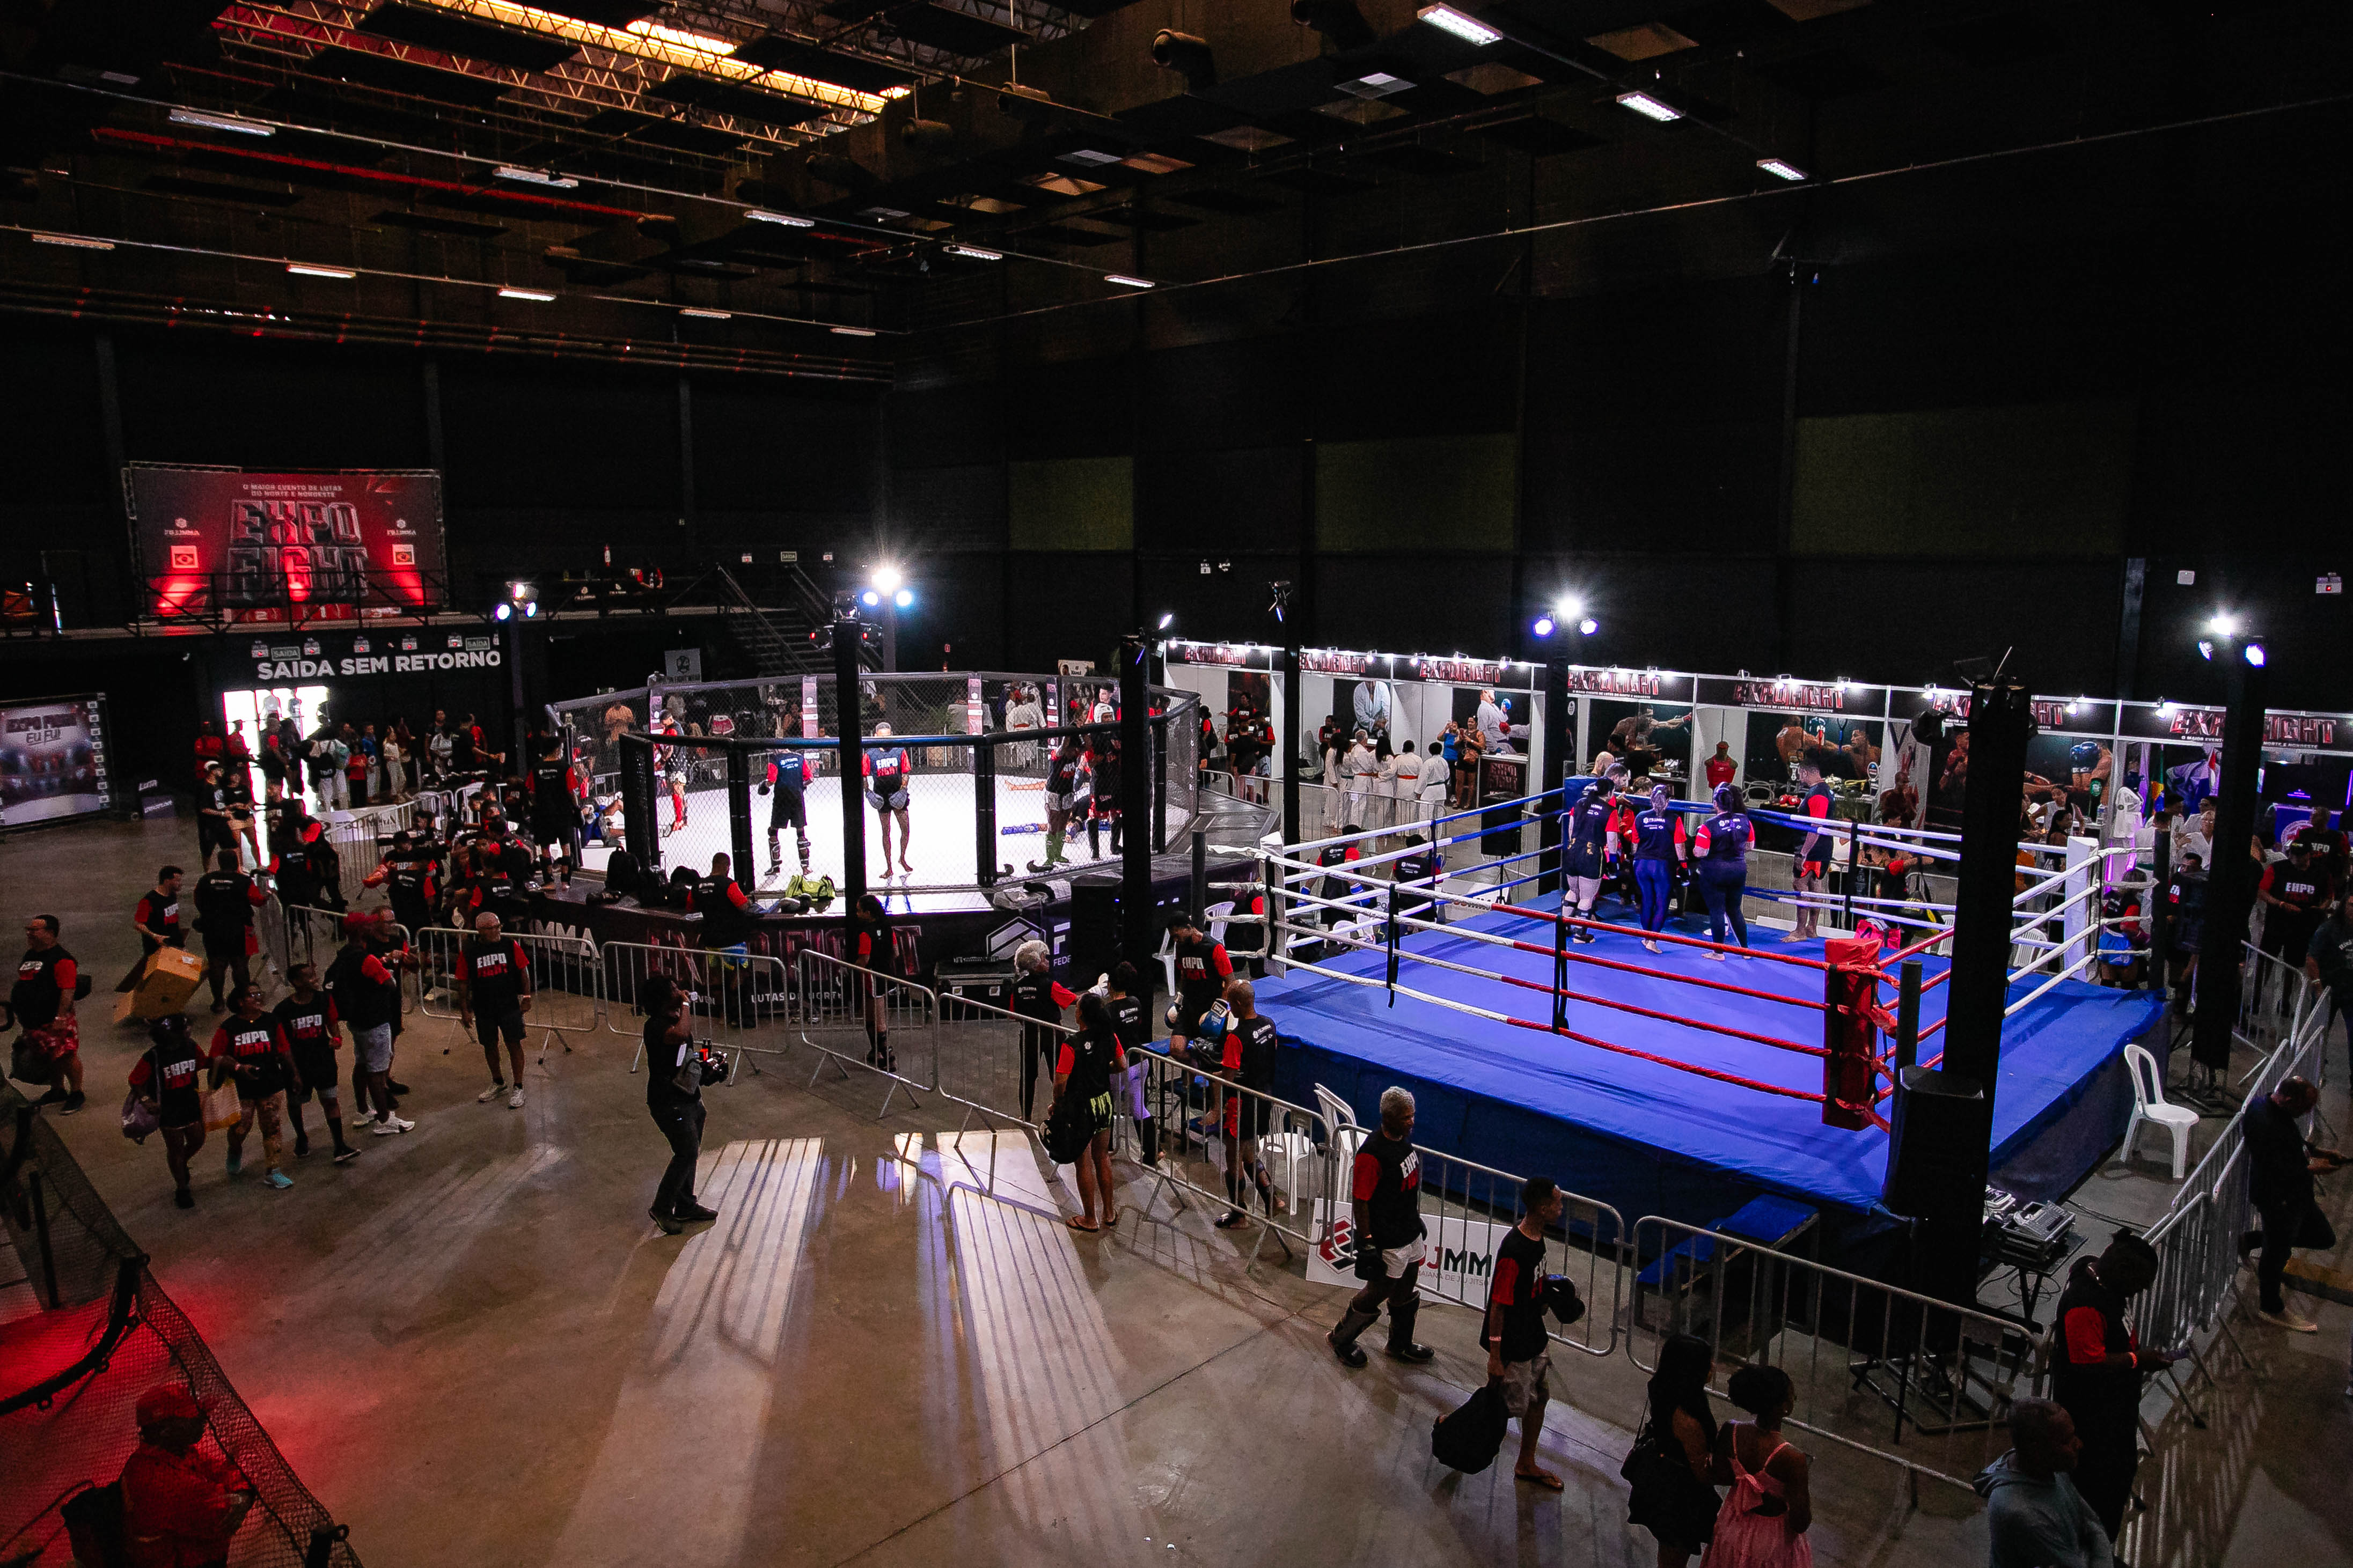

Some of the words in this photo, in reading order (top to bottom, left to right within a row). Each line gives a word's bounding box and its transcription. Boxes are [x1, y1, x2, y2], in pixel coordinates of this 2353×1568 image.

[258, 660, 335, 680] SAIDA
[340, 656, 389, 675] SEM
[395, 651, 501, 672] RETORNO
[751, 991, 786, 1003] LUTAS
[1445, 1273, 1456, 1282] DE
